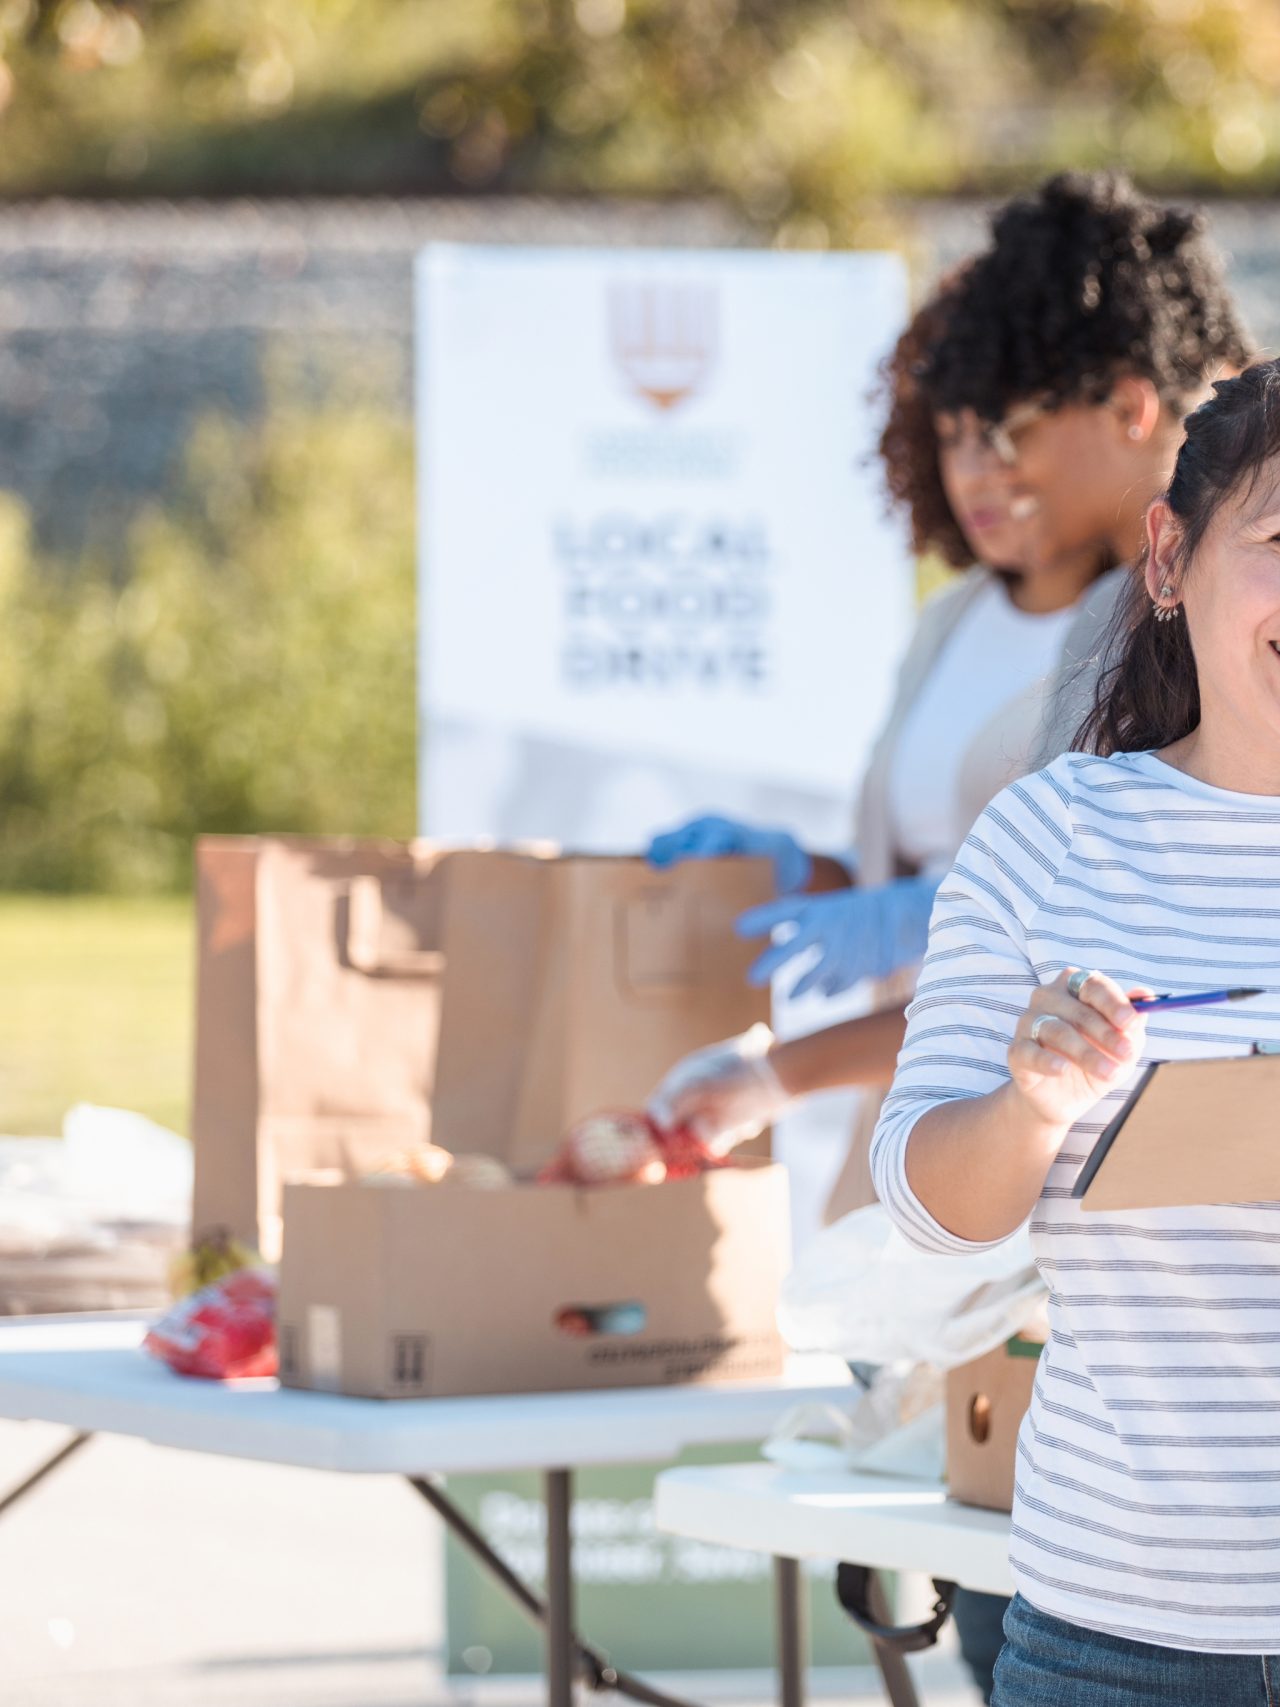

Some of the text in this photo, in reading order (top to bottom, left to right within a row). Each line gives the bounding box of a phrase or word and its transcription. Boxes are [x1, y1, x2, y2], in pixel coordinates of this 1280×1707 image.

[552, 514, 771, 562] LOCAL
[563, 577, 771, 627] FOOD
[560, 639, 771, 690] DRIVE
